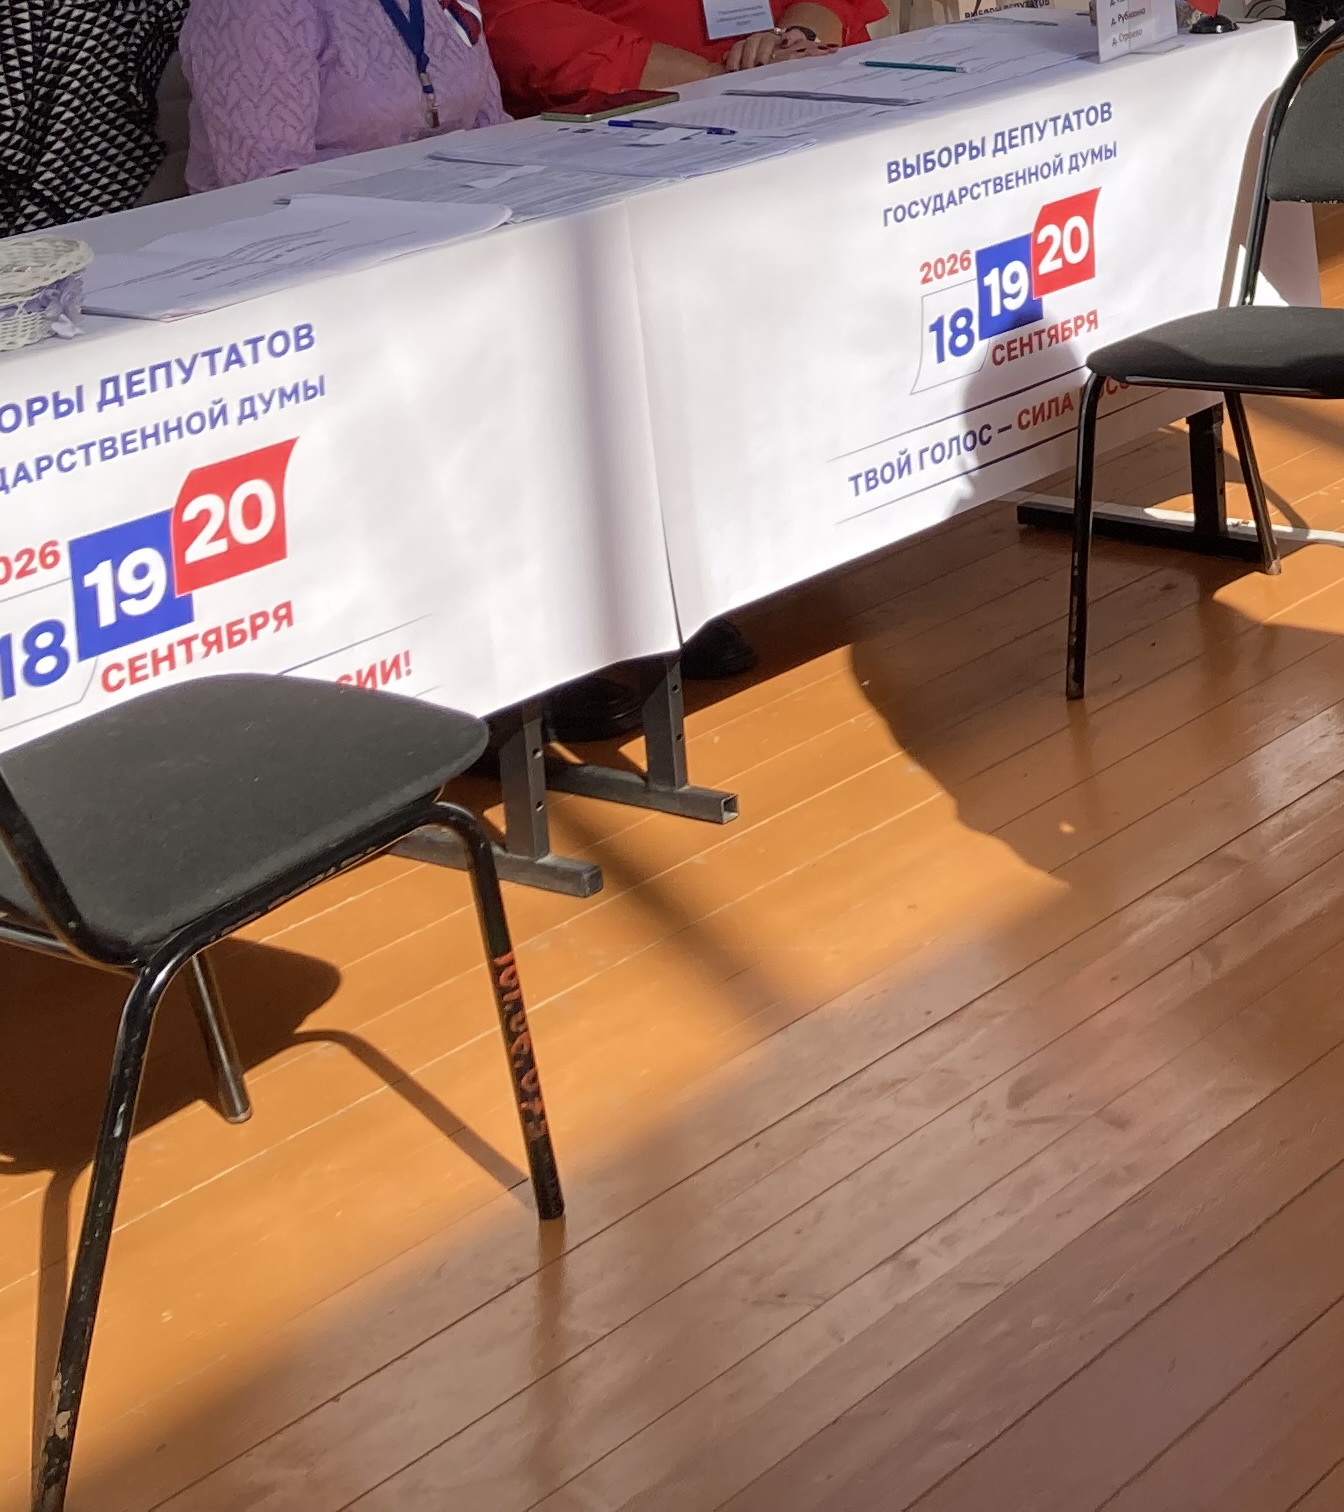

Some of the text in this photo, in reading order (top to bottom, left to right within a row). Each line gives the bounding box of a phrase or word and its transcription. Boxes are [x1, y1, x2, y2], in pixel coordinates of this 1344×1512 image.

[886, 101, 1113, 184] ВЫБОРЫ ДЕПУТАТОВ
[882, 141, 1118, 228] ГОСУДАРСТВЕННОЙ ДУМЫ
[919, 249, 972, 285] 2026
[1037, 216, 1090, 276] 20
[983, 259, 1029, 318] 19
[96, 322, 316, 412] ДЕПУТАТОВ
[929, 308, 974, 364] 18
[991, 309, 1099, 367] СЕНТЯБРЯ
[236, 374, 326, 426] ДУМЫ
[848, 449, 913, 498] ТВОЙ
[918, 423, 992, 472] ГОЛОС
[1017, 391, 1074, 431] СИЛА
[181, 478, 278, 566] 20
[83, 546, 169, 629] 19
[101, 600, 295, 694] СЕНТЯБРЯ
